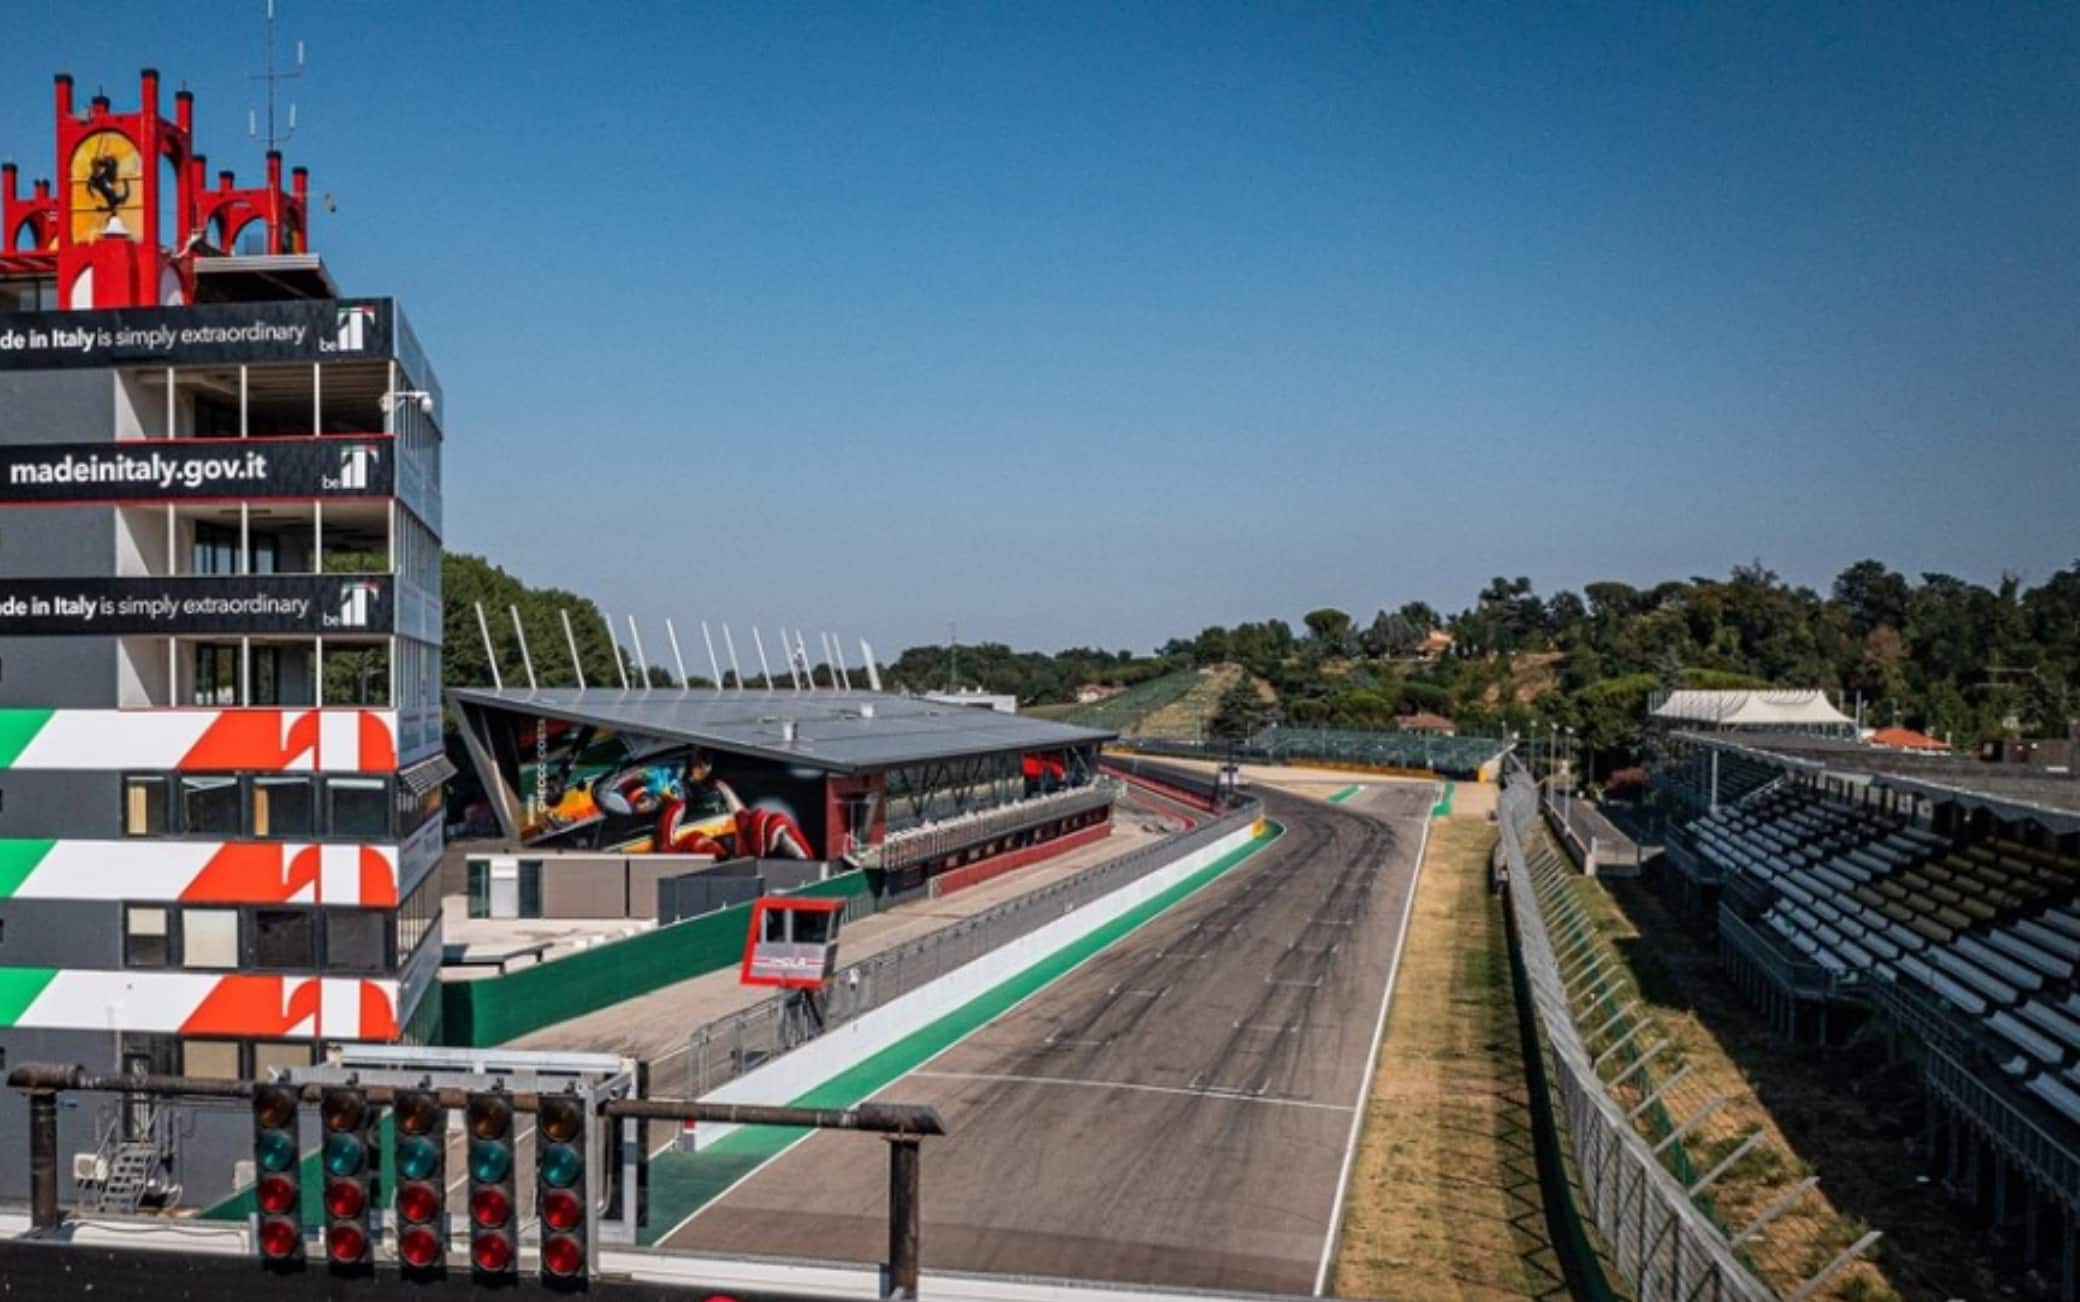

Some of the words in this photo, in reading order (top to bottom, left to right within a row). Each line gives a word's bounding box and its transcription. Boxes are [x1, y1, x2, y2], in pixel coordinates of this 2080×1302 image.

[30, 329, 48, 348] in
[52, 326, 95, 352] Italy
[98, 326, 112, 346] is
[116, 323, 176, 349] simply
[181, 320, 306, 345] extraordinary
[10, 452, 267, 487] madeinitaly.gov.it
[0, 594, 28, 616] de
[31, 595, 50, 616] in
[54, 594, 97, 621] Italy
[100, 596, 114, 615] is
[117, 593, 179, 620] simply
[183, 592, 309, 618] extraordinary
